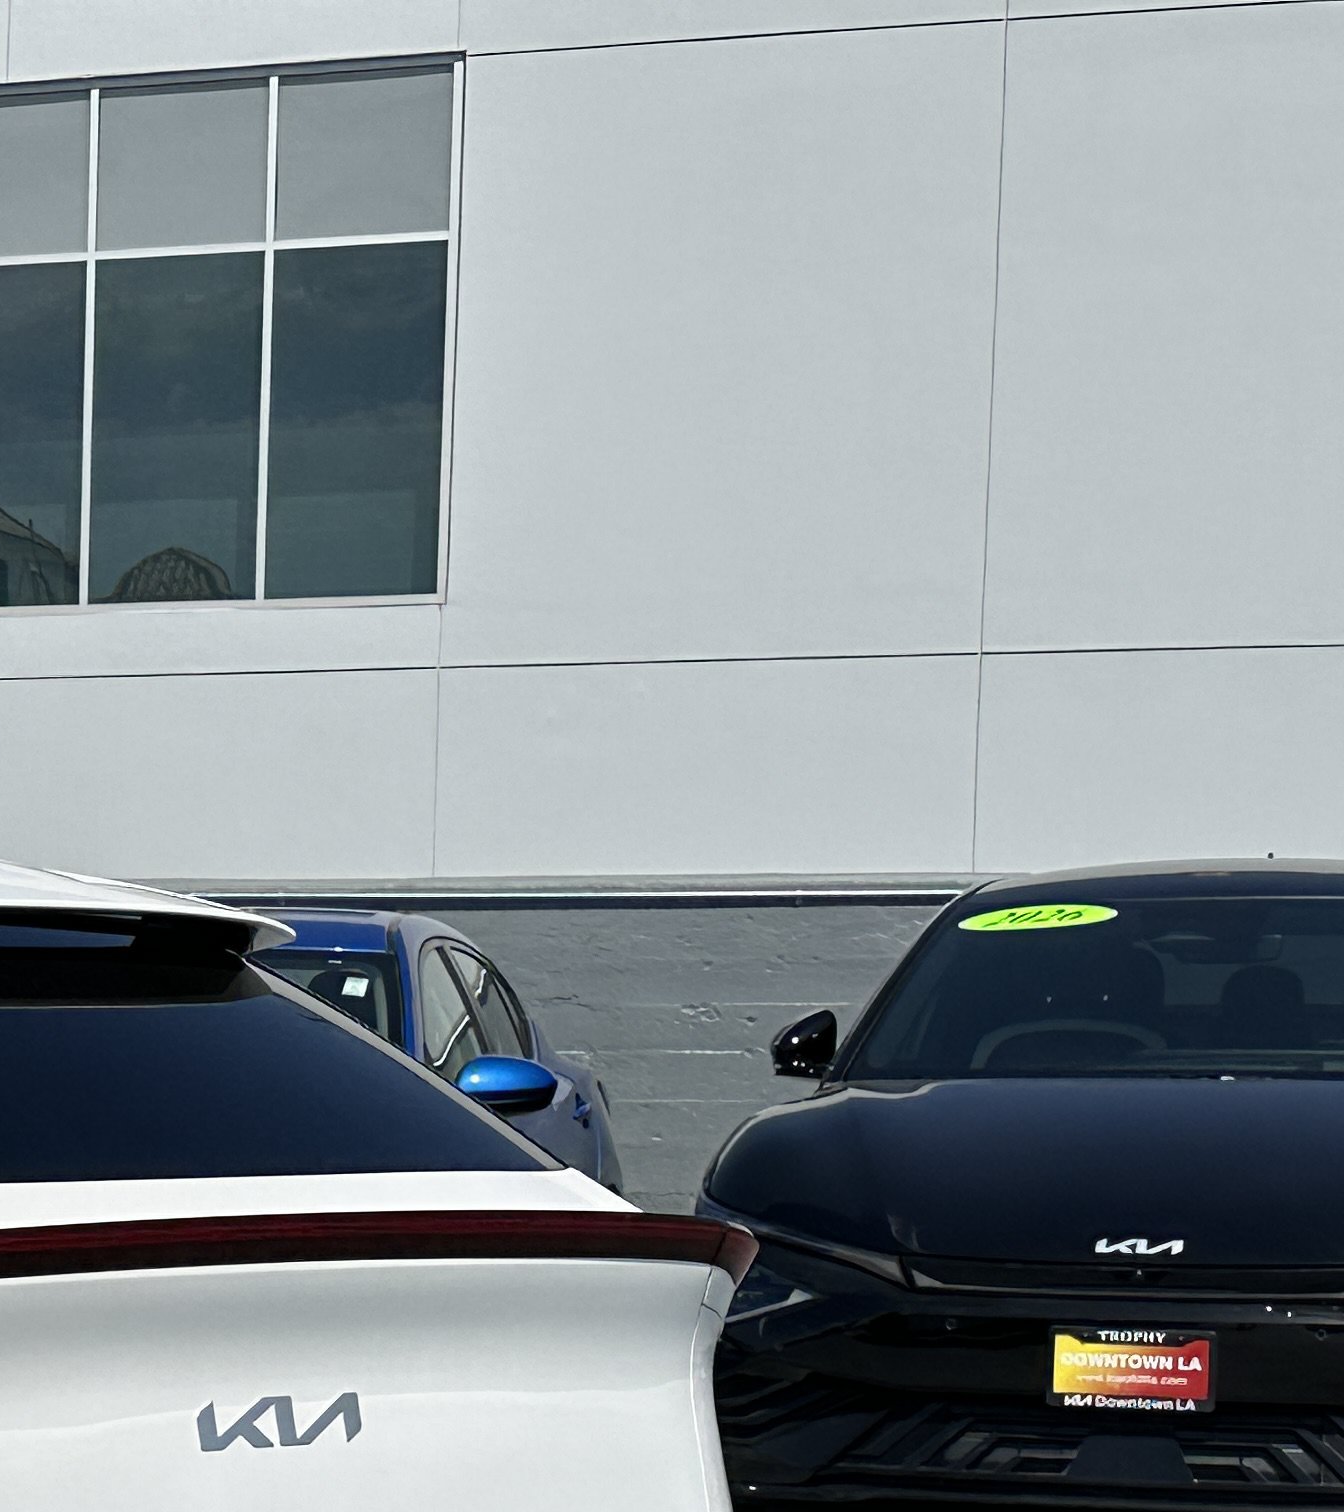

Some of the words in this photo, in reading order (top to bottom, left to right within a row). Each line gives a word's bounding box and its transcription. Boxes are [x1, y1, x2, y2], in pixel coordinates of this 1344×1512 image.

[1095, 1238, 1184, 1255] KIA
[1097, 1330, 1167, 1344] TROPHY
[1061, 1352, 1174, 1371] DOWNTOWN
[1178, 1356, 1202, 1371] LA
[1094, 1396, 1174, 1411] Downtown
[1176, 1398, 1196, 1411] LA
[196, 1392, 362, 1452] KIA
